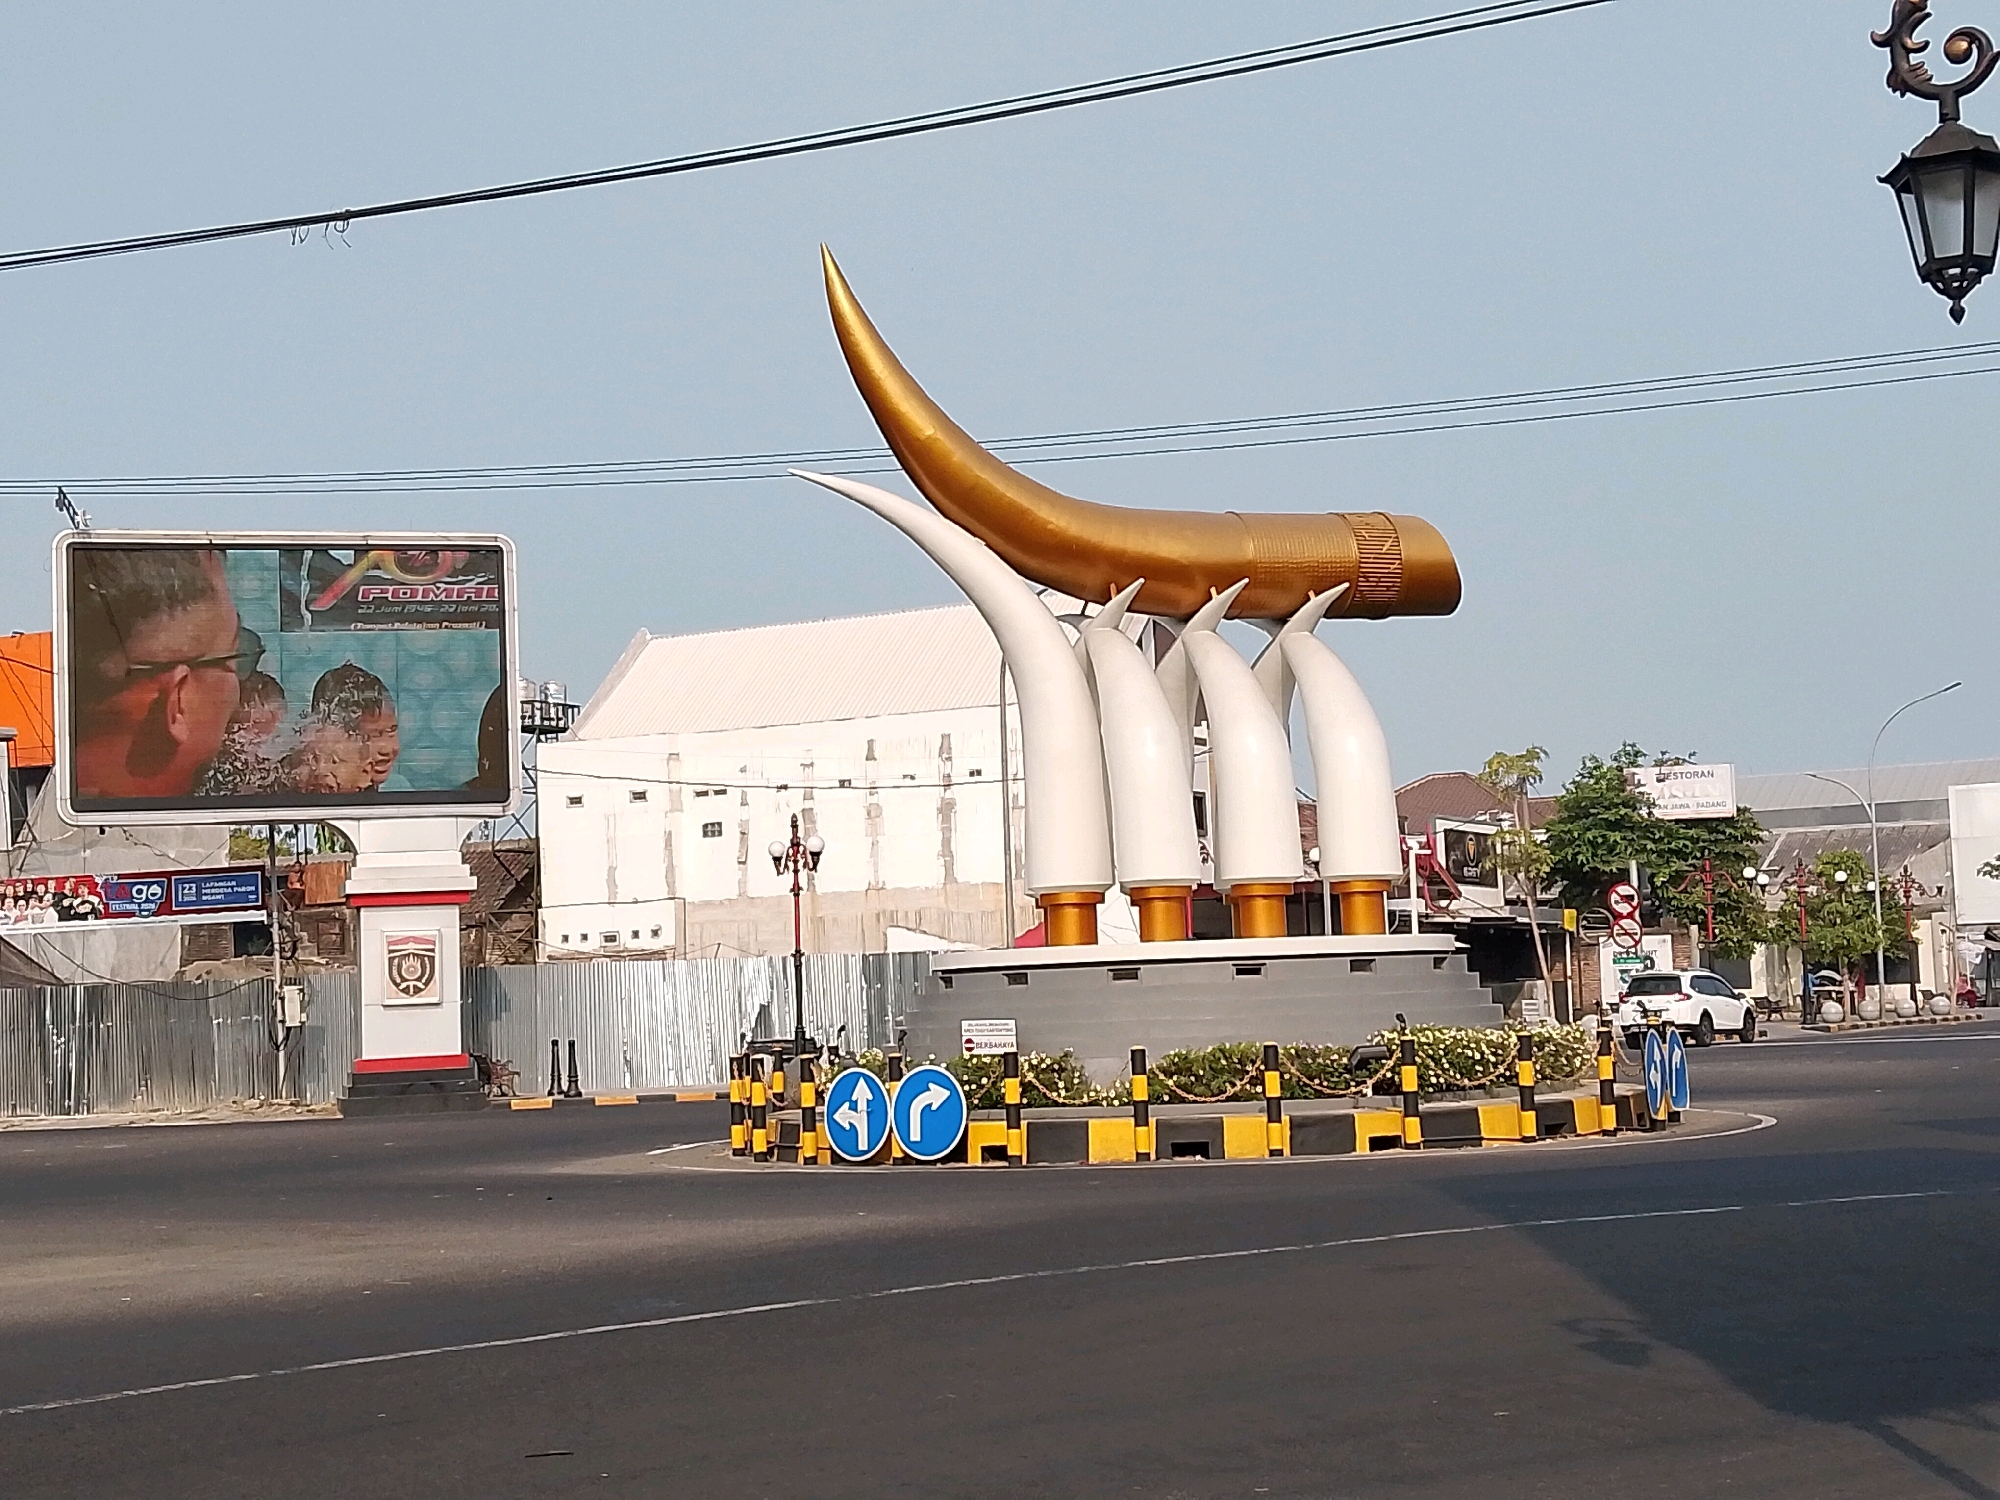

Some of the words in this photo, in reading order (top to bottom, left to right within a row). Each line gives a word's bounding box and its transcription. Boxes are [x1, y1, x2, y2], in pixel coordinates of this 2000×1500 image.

[1660, 769, 1714, 781] ESTORAN
[1696, 801, 1727, 809] PADANG
[183, 883, 197, 893] 23
[976, 1041, 1015, 1049] BERBAHAYA
